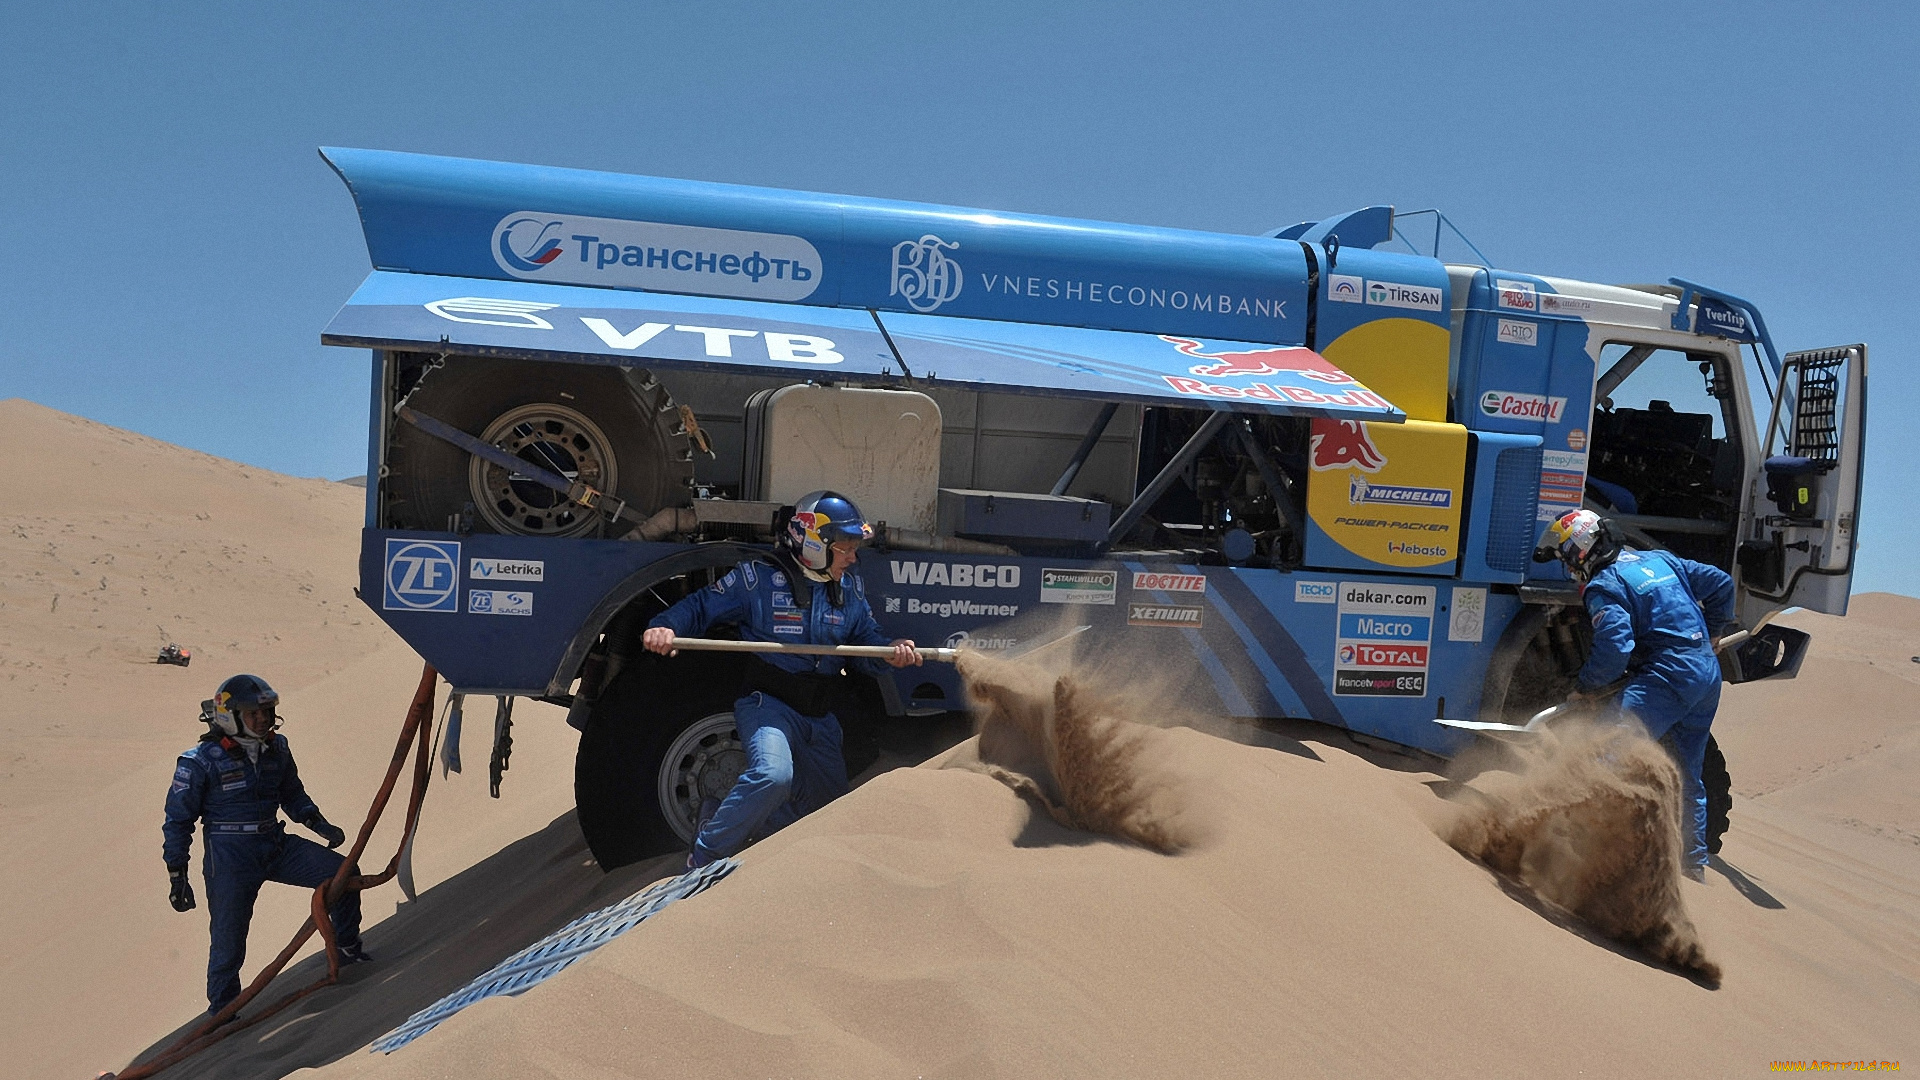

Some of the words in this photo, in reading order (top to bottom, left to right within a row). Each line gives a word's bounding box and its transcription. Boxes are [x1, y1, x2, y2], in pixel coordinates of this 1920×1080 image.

[571, 234, 813, 283] Транснефть
[981, 273, 1287, 319] VNESHECONOMBANK
[1705, 307, 1745, 328] TverTrip
[579, 317, 845, 364] VTB
[1162, 375, 1284, 402] Red
[1274, 386, 1394, 411] Bull
[1501, 396, 1559, 418] Castrol
[1370, 488, 1448, 502] MICHELIN
[1334, 517, 1450, 532] POWER-PACKER
[1388, 541, 1447, 557] Webasto
[393, 556, 450, 595] ZF
[496, 562, 542, 576] Letrika
[890, 561, 1021, 588] WABCO
[1135, 574, 1204, 591] LOCTITE
[1300, 584, 1333, 596] TECHO
[473, 595, 489, 607] ZF
[1346, 588, 1427, 607] dakar.com
[498, 607, 531, 615] SACHS
[907, 598, 1019, 618] BorgWarner
[1357, 618, 1413, 637] Macro
